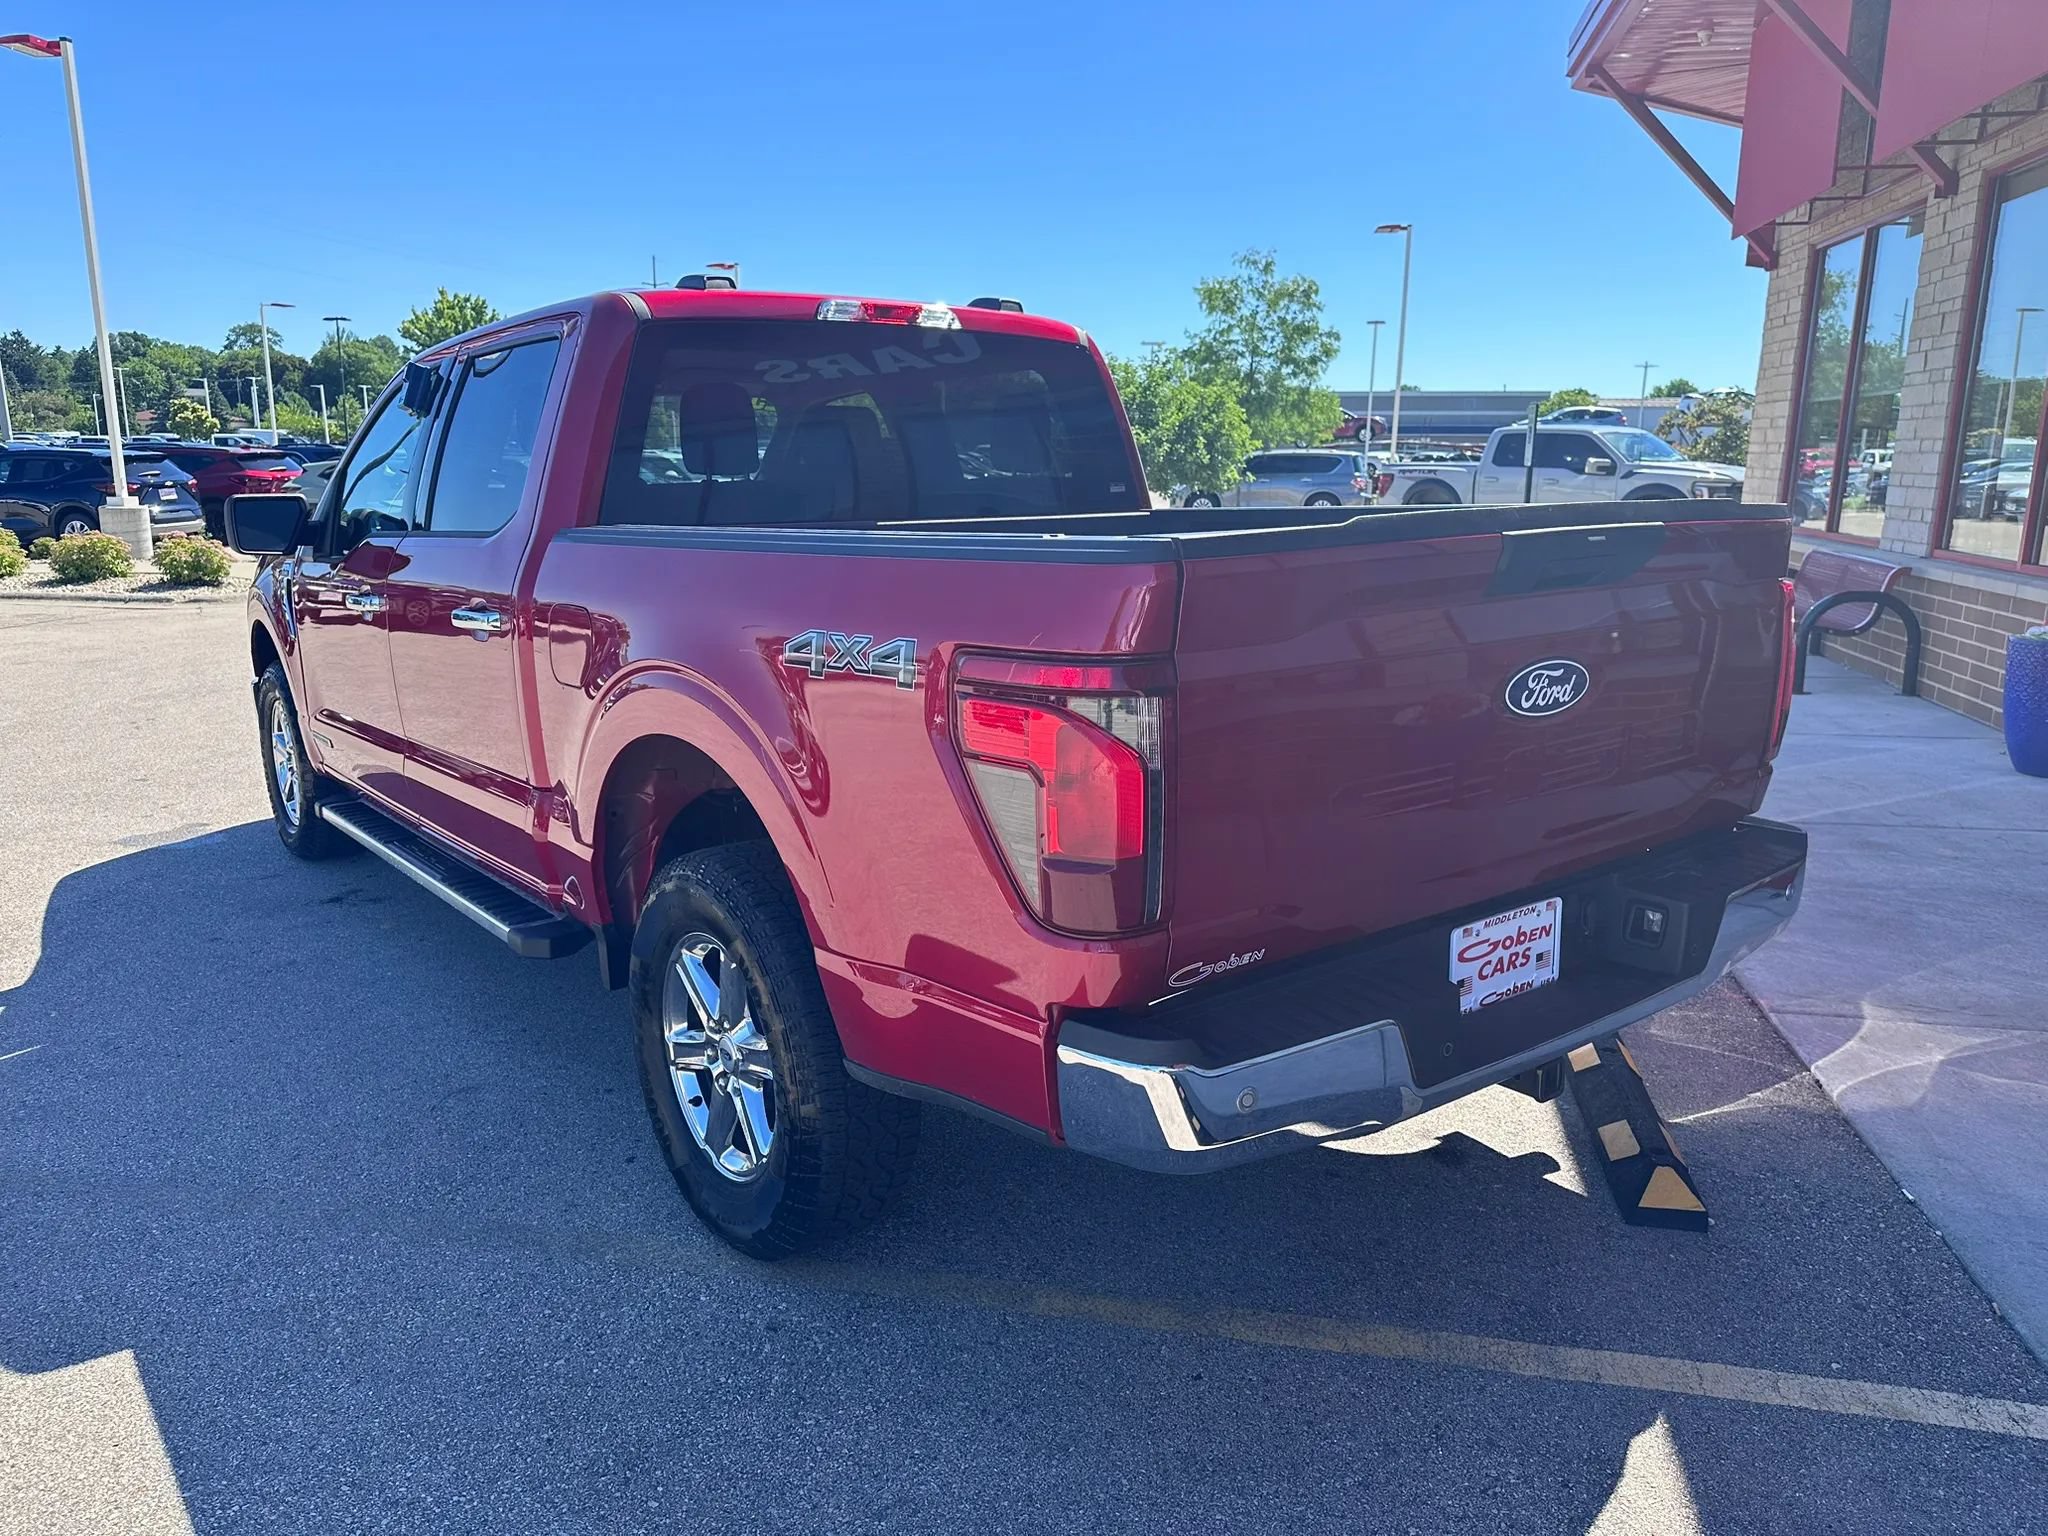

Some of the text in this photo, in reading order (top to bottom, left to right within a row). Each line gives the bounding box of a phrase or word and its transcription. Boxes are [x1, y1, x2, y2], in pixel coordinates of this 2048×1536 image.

[1521, 668, 1576, 709] Ford
[1483, 905, 1537, 929] MIDDLETON
[1477, 947, 1532, 981] CARS
